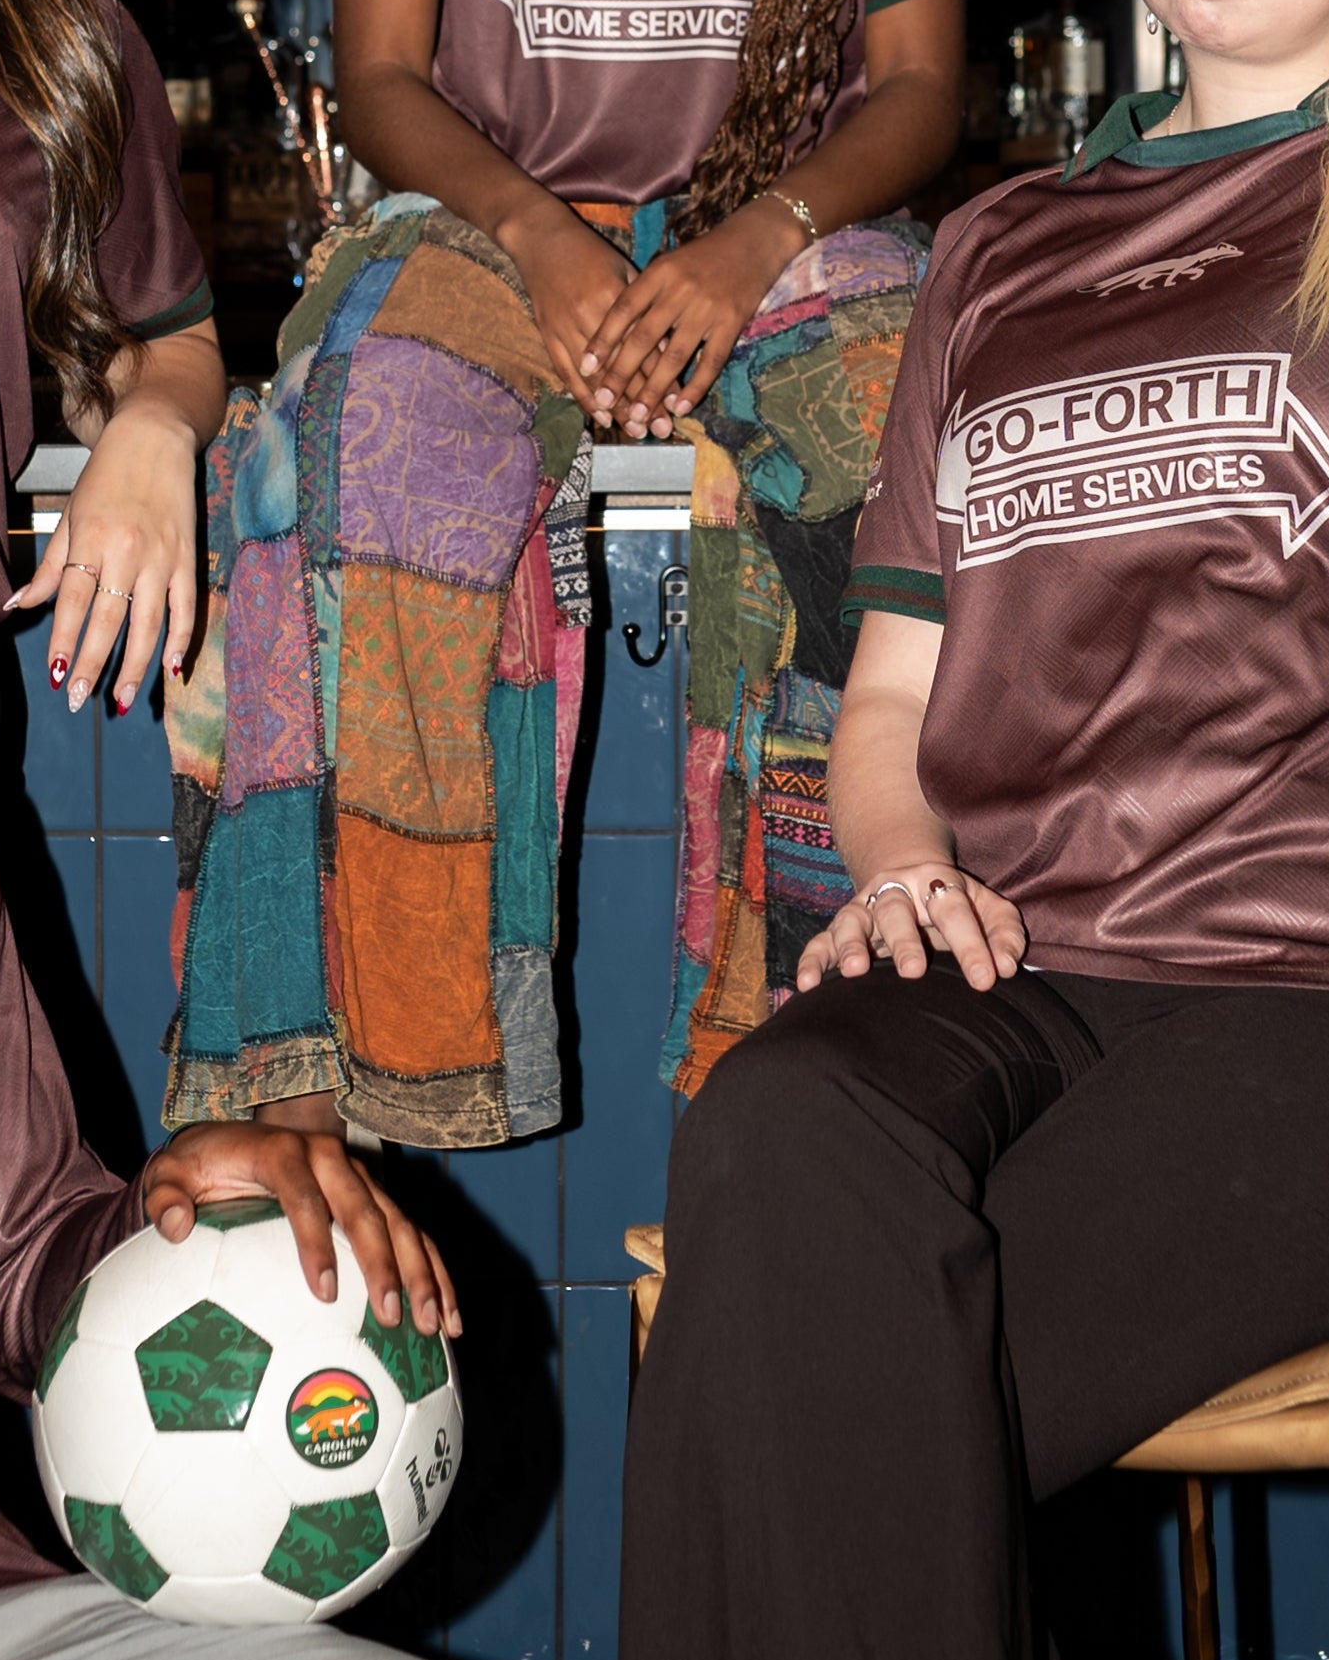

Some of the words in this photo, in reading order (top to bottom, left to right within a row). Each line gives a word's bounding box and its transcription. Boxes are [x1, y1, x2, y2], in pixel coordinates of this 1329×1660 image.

[531, 8, 621, 36] HOME
[628, 8, 749, 37] SERVICE
[965, 370, 1260, 466] GO-FORTH
[968, 479, 1075, 537] HOME
[1083, 454, 1265, 509] SERVICES
[304, 1435, 368, 1456] CAROLINA
[320, 1449, 354, 1465] CORE
[405, 1455, 430, 1527] hummel
